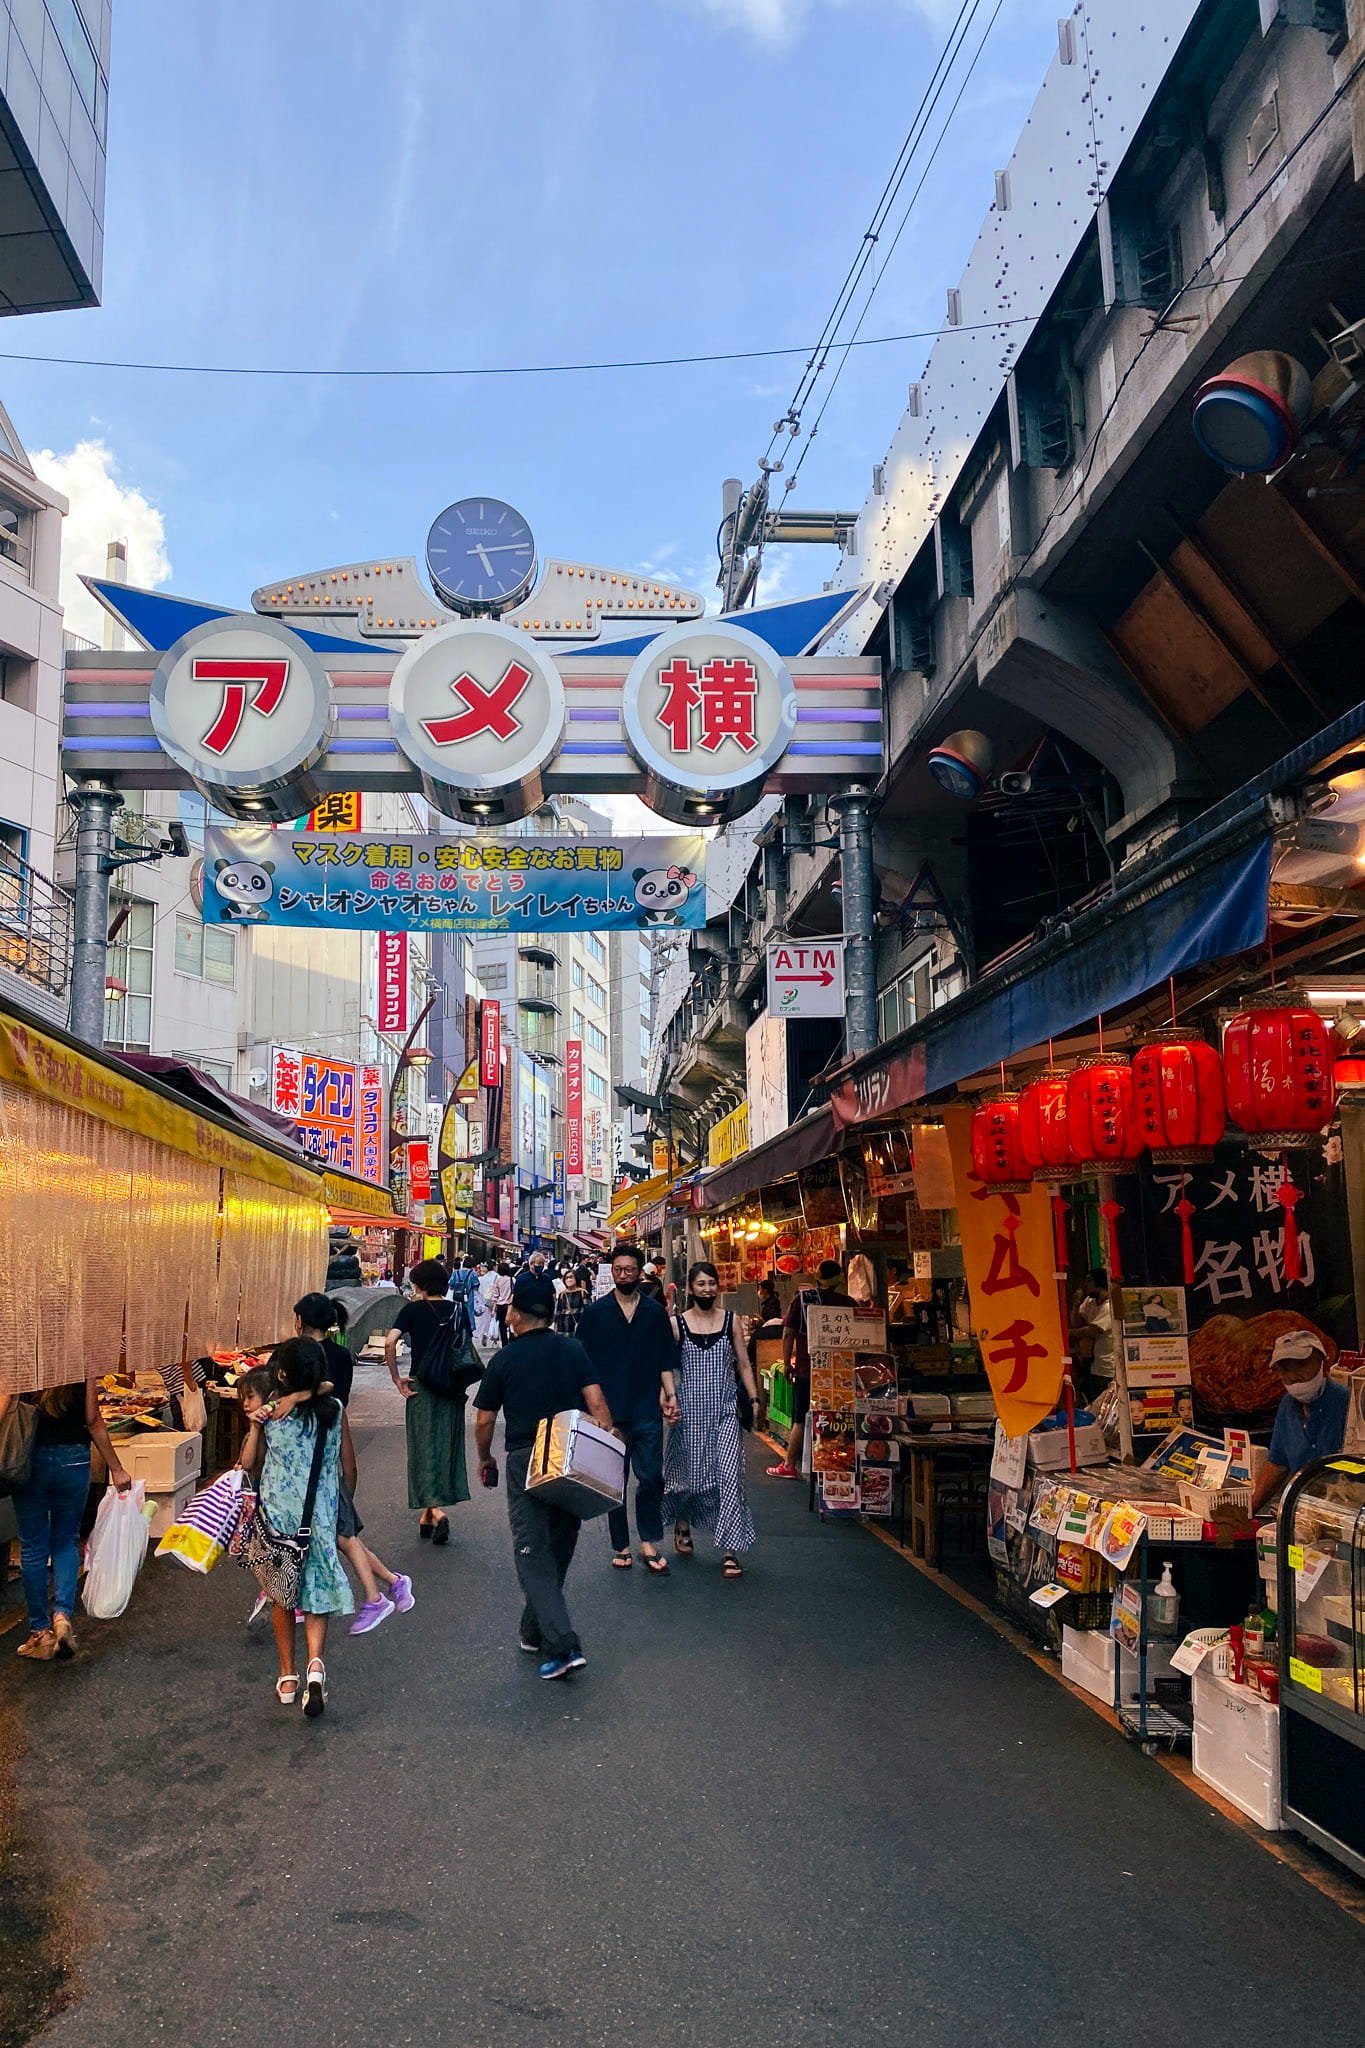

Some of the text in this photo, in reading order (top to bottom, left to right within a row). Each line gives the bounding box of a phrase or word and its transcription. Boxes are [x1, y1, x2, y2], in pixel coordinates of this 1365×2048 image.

[465, 527, 498, 536] SEIKO
[191, 657, 760, 756] アメ横
[292, 841, 624, 871] マスク着用・安心安全なお買物
[279, 887, 634, 918] シャオシャオちゃん レイレイちゃん
[370, 871, 526, 892] 命名おめでとう
[384, 938, 401, 1029] サンドラッグ
[775, 949, 836, 969] ATM
[485, 1018, 497, 1080] GAME
[274, 1052, 300, 1112] 薬
[303, 1063, 354, 1119] ダイコク
[568, 1048, 581, 1101] カラオケ
[363, 1090, 379, 1134] ダイコク
[1153, 1165, 1294, 1213] アメ横
[1193, 1226, 1314, 1304] 名物
